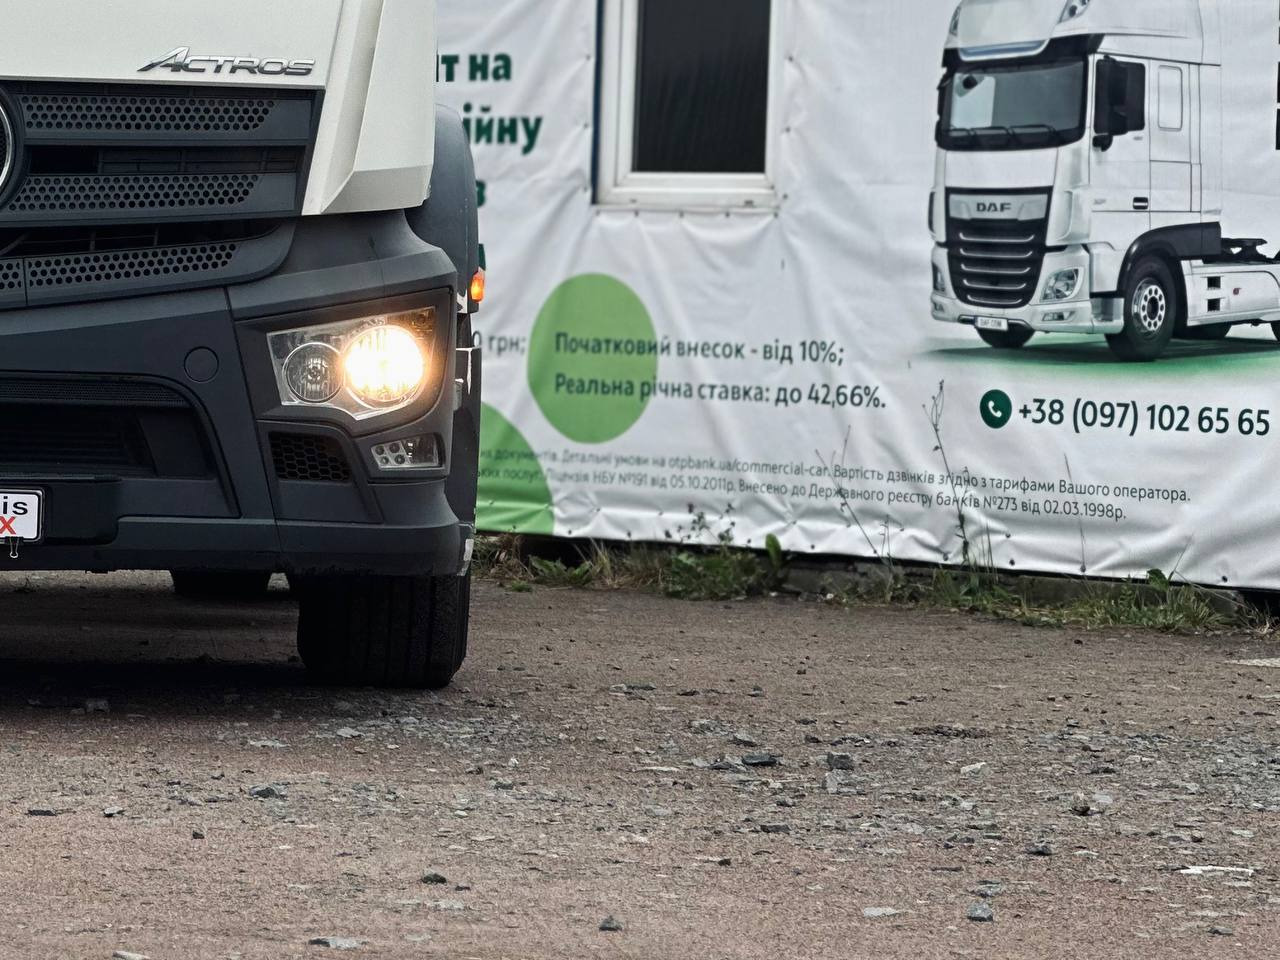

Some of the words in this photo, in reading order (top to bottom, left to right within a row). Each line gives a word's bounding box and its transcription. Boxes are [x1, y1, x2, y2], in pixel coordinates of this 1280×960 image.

[469, 53, 512, 82] на
[976, 202, 1012, 213] DAF
[488, 335, 526, 357] грн;
[555, 331, 671, 356] Початковий
[676, 340, 746, 359] внесок
[762, 338, 794, 365] від
[800, 340, 845, 367] 10%;
[555, 372, 635, 397] Реальна
[640, 376, 694, 402] річна
[698, 383, 771, 403] ставка:
[775, 386, 803, 408] до
[807, 383, 887, 409] 42,66%.
[1018, 398, 1065, 425] +38
[1072, 397, 1139, 437] (097)
[1146, 404, 1190, 432] 102
[1197, 406, 1230, 434] 65
[1237, 408, 1270, 436] 65
[739, 479, 789, 495] Внесено
[791, 486, 807, 498] до
[887, 491, 933, 508] реєстру
[936, 490, 981, 508] банків
[1021, 498, 1041, 515] від
[1043, 499, 1127, 522] 02.03.1998р.
[834, 464, 884, 481] Вартість
[886, 470, 935, 485] дзвінків
[981, 478, 988, 489] з
[989, 476, 1056, 493] тарифами
[1058, 479, 1111, 497] Вашого
[1113, 485, 1191, 504] оператора.
